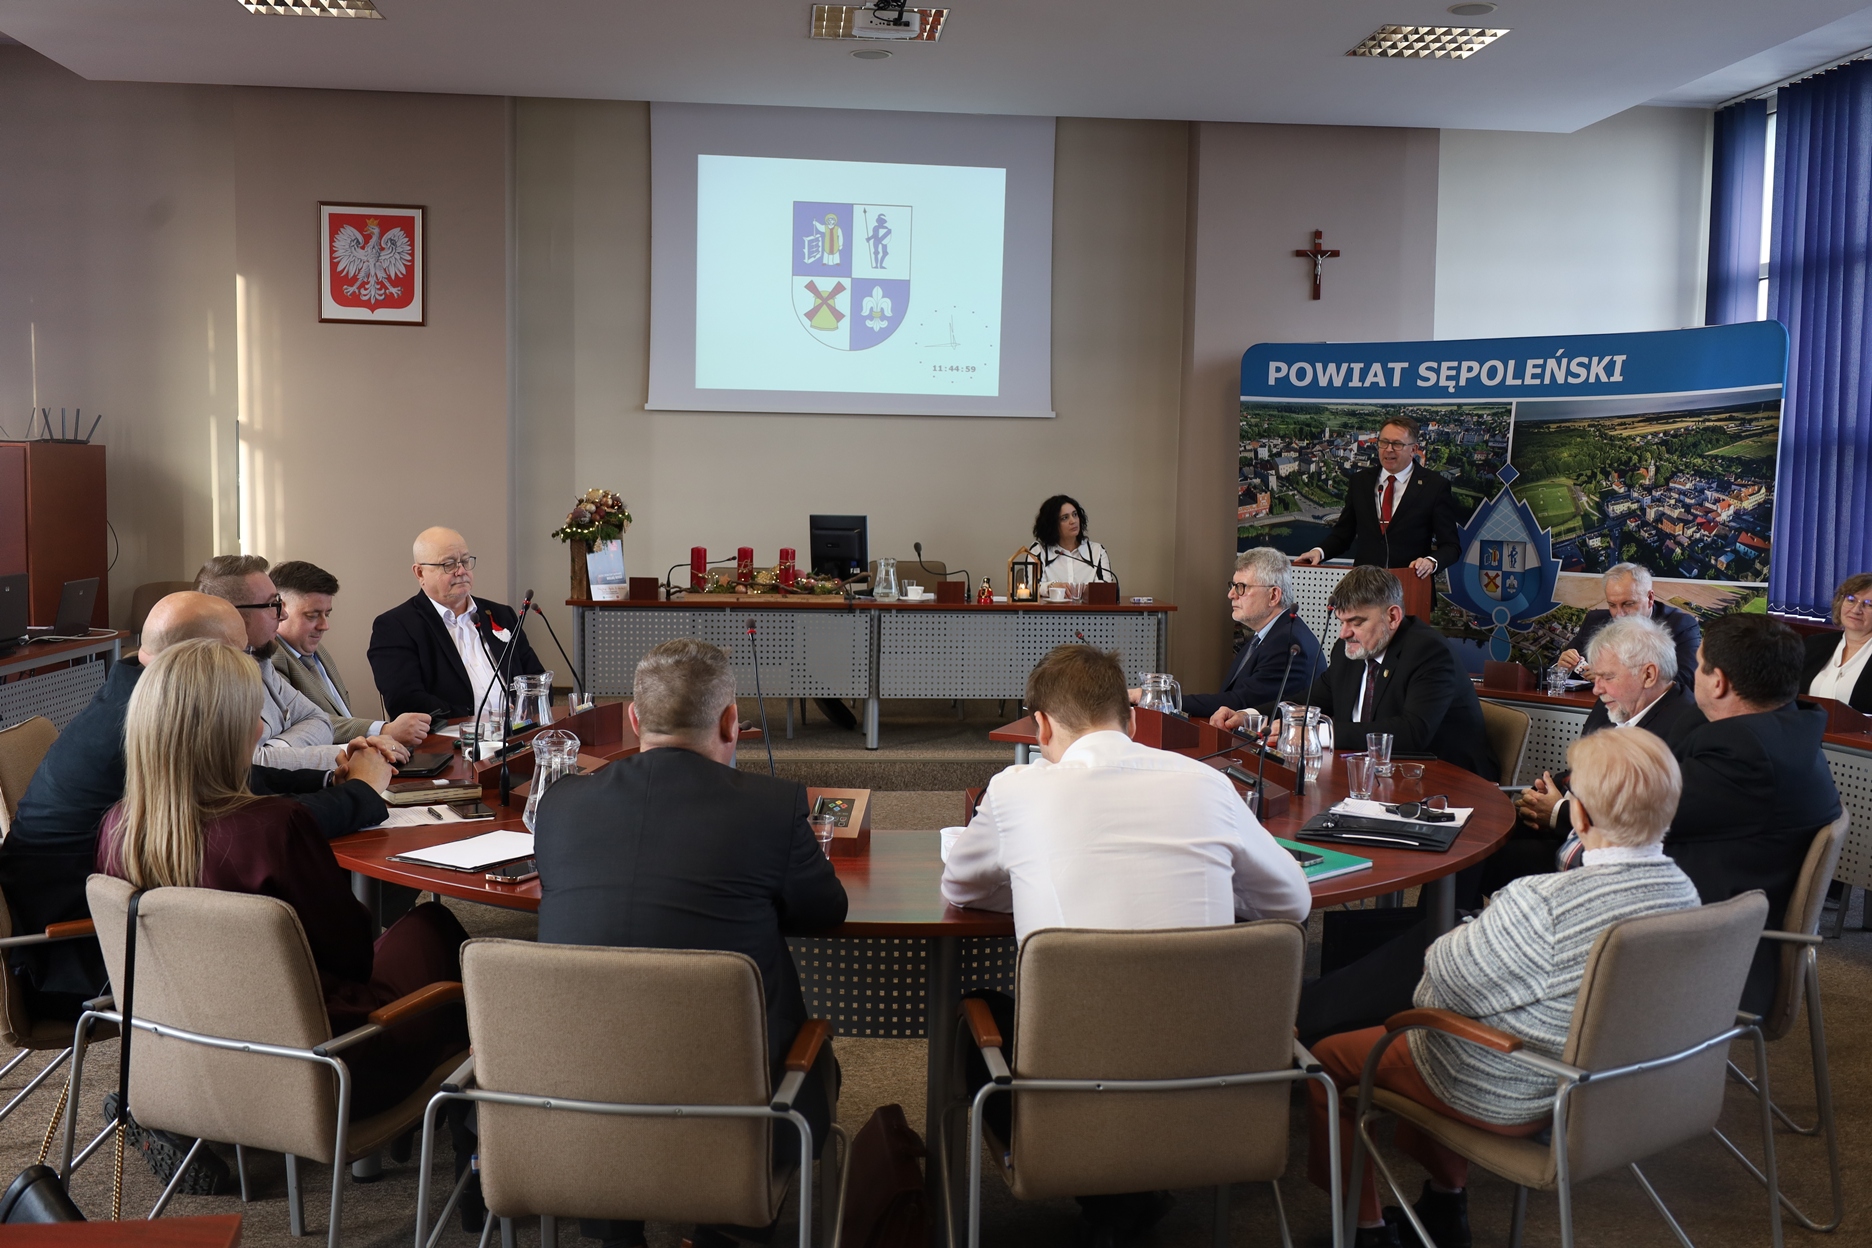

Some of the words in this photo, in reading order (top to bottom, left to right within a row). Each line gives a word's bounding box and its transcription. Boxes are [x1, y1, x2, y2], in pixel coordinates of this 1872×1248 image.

[932, 365, 977, 373] 11:44:59
[1267, 361, 1408, 387] POWIAT
[1416, 349, 1627, 393] SĘPOLEŃSKI
